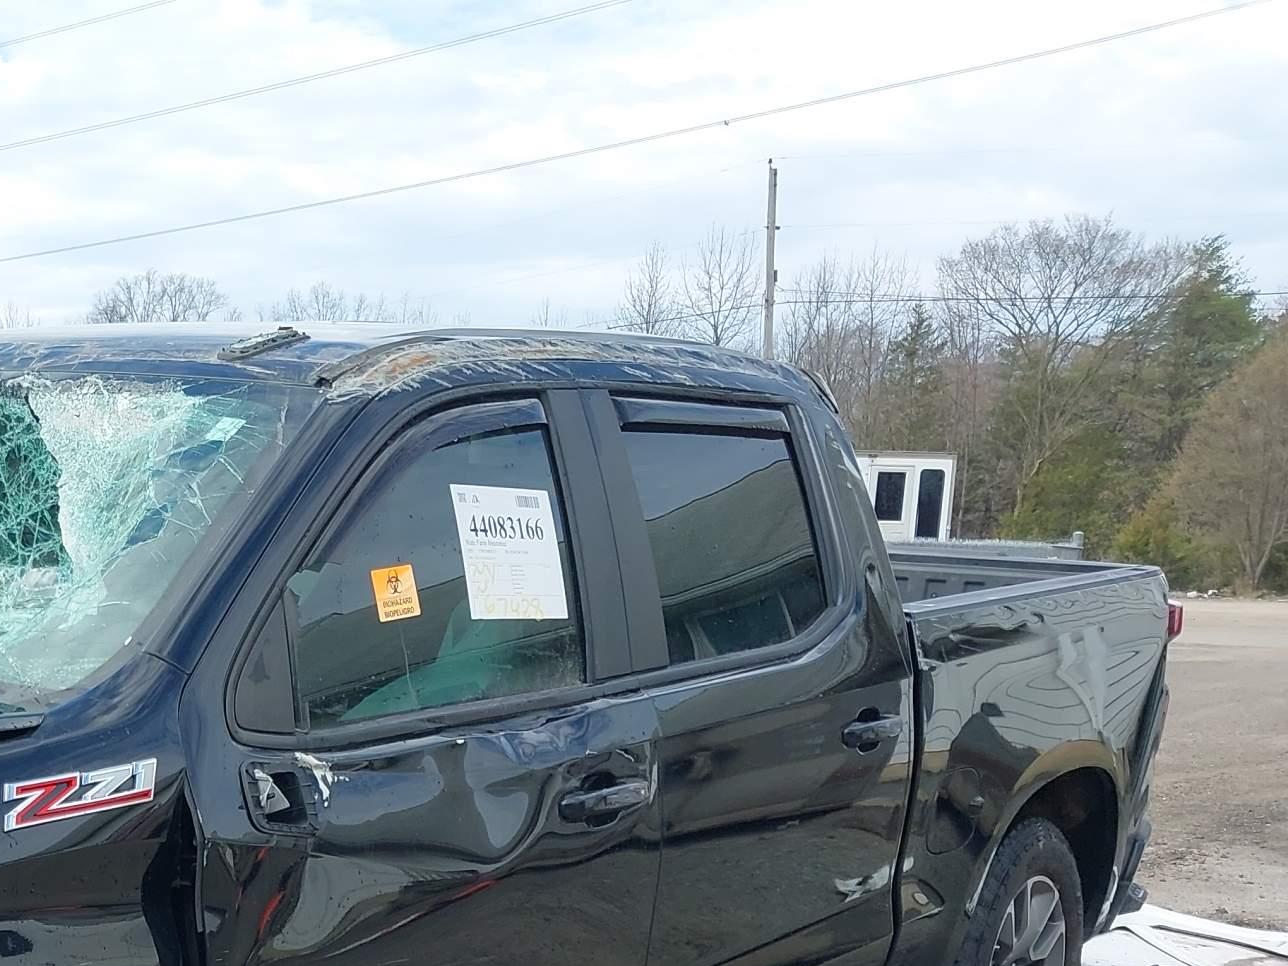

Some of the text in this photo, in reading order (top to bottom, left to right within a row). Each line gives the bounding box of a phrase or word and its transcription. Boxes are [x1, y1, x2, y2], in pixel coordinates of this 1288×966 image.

[469, 513, 544, 540] 44083166
[382, 597, 413, 608] BIOHAZARD
[384, 607, 415, 618] BIOPELIGRO
[3, 758, 158, 832] Z71
